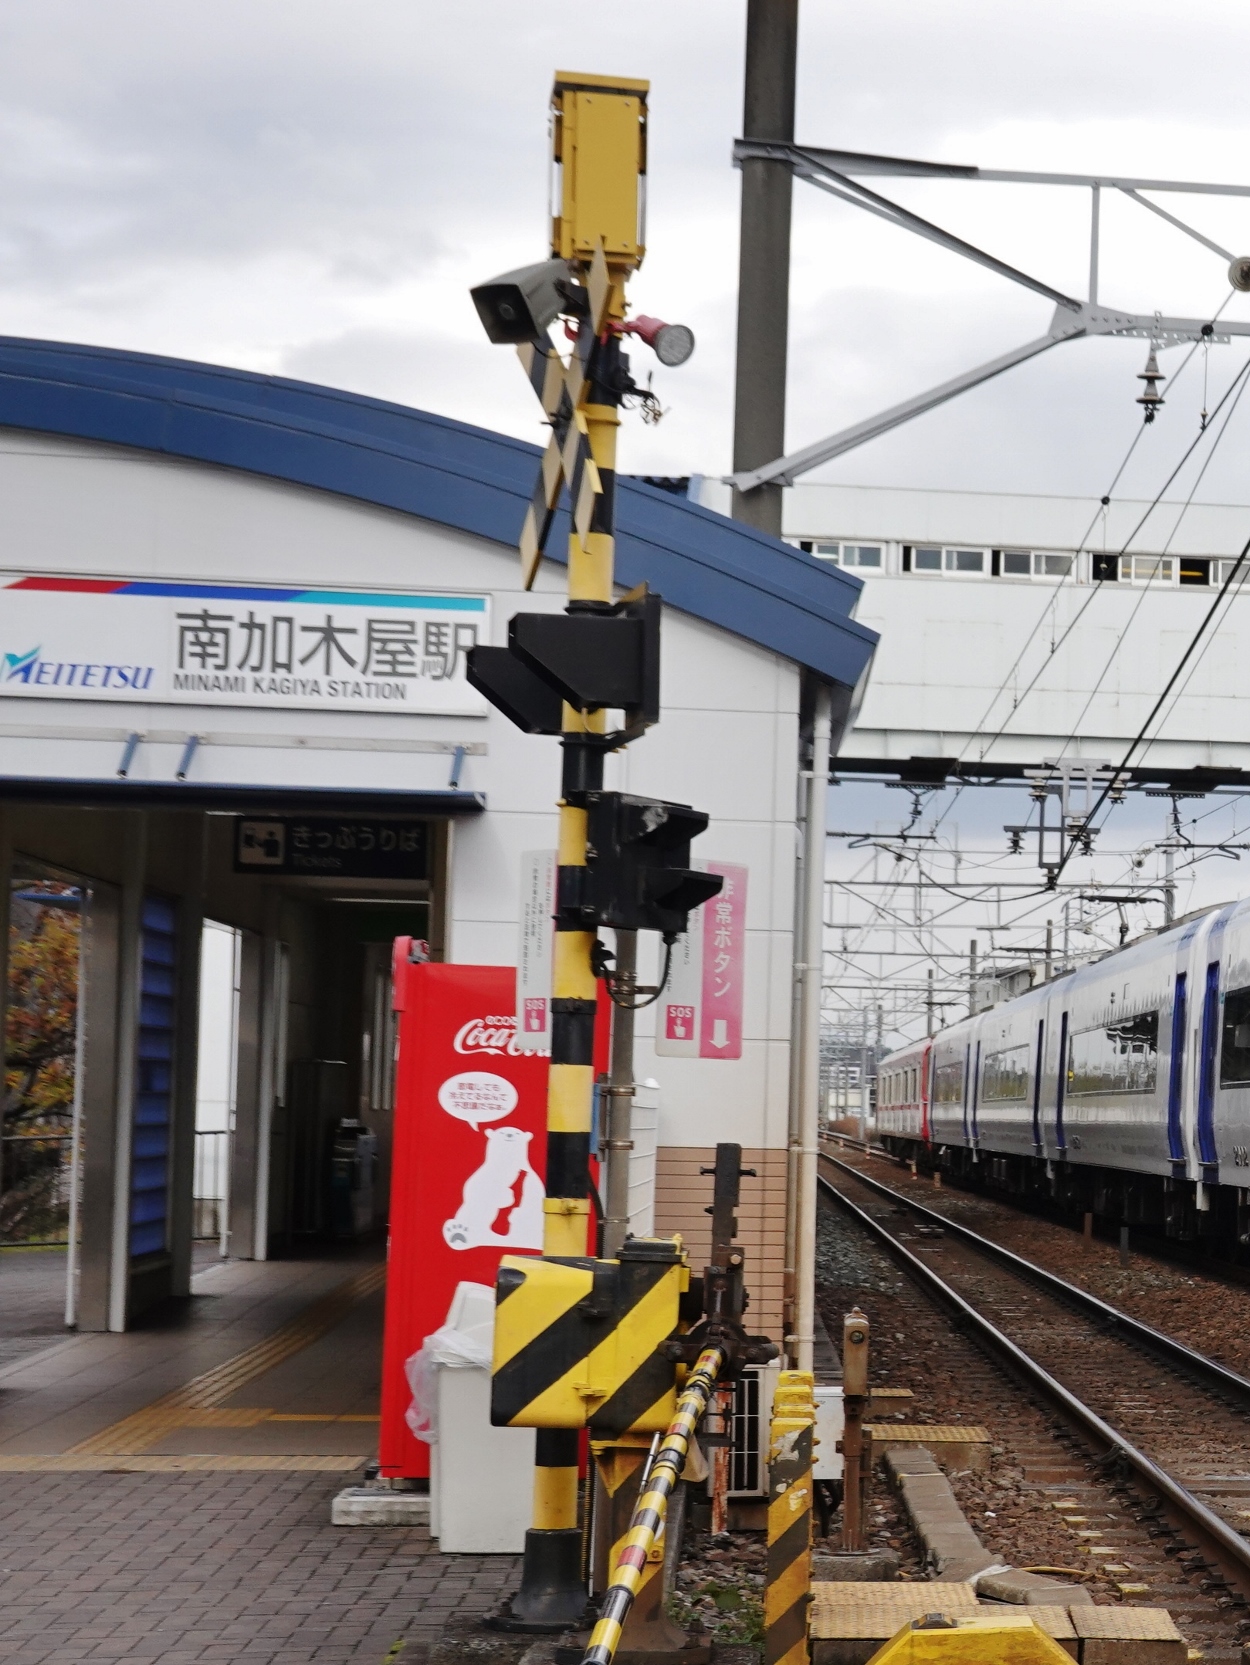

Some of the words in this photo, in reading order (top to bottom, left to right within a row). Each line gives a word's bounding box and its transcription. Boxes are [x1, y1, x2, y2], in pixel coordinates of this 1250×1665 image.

[176, 609, 480, 682] 南加木屋駅
[4, 645, 155, 690] MEITETSU
[173, 673, 246, 694] MINAMI
[253, 675, 322, 697] KAGIYA
[326, 680, 407, 700] STATION
[292, 826, 421, 851] きっぷうりば
[525, 1000, 545, 1010] SOS
[669, 1007, 692, 1018] SOS
